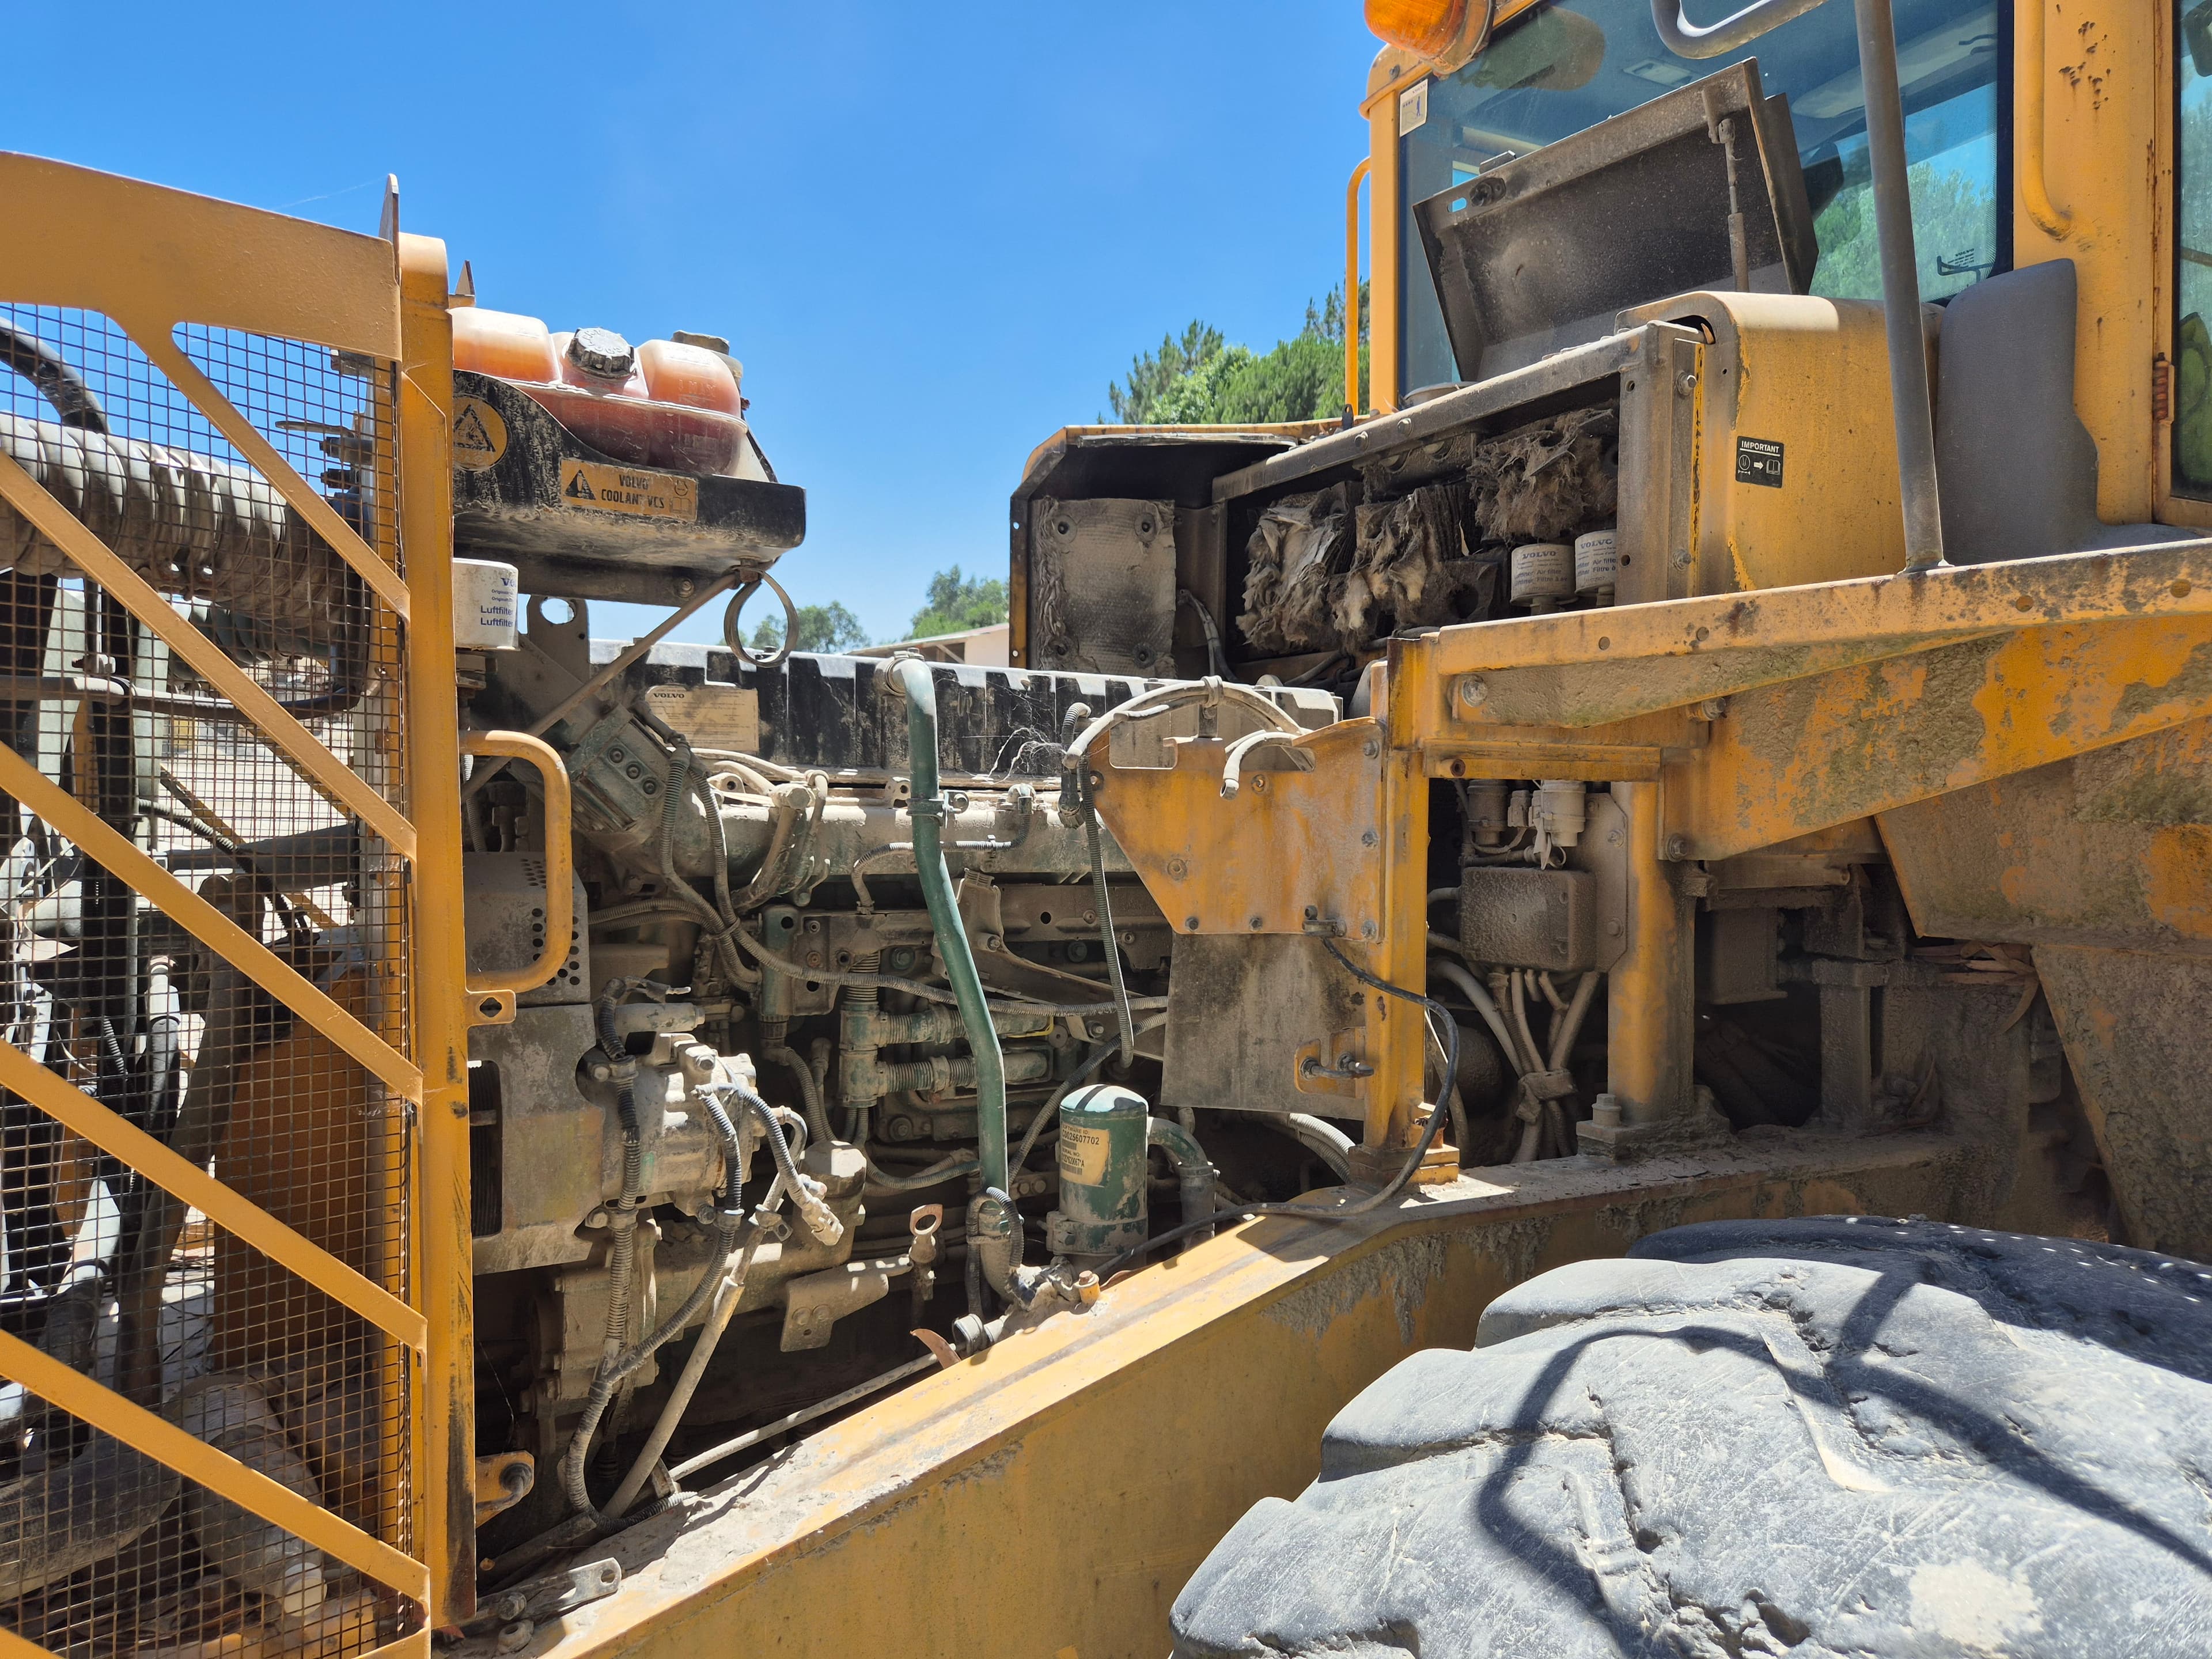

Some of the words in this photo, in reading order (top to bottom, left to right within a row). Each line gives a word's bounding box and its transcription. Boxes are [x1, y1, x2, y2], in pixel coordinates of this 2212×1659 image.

[1955, 248, 1974, 256] VOLVO
[1741, 440, 1779, 453] IMPORTANT
[619, 474, 649, 490] VOLVO
[647, 495, 665, 509] VCS
[1522, 551, 1556, 559] VOLVO
